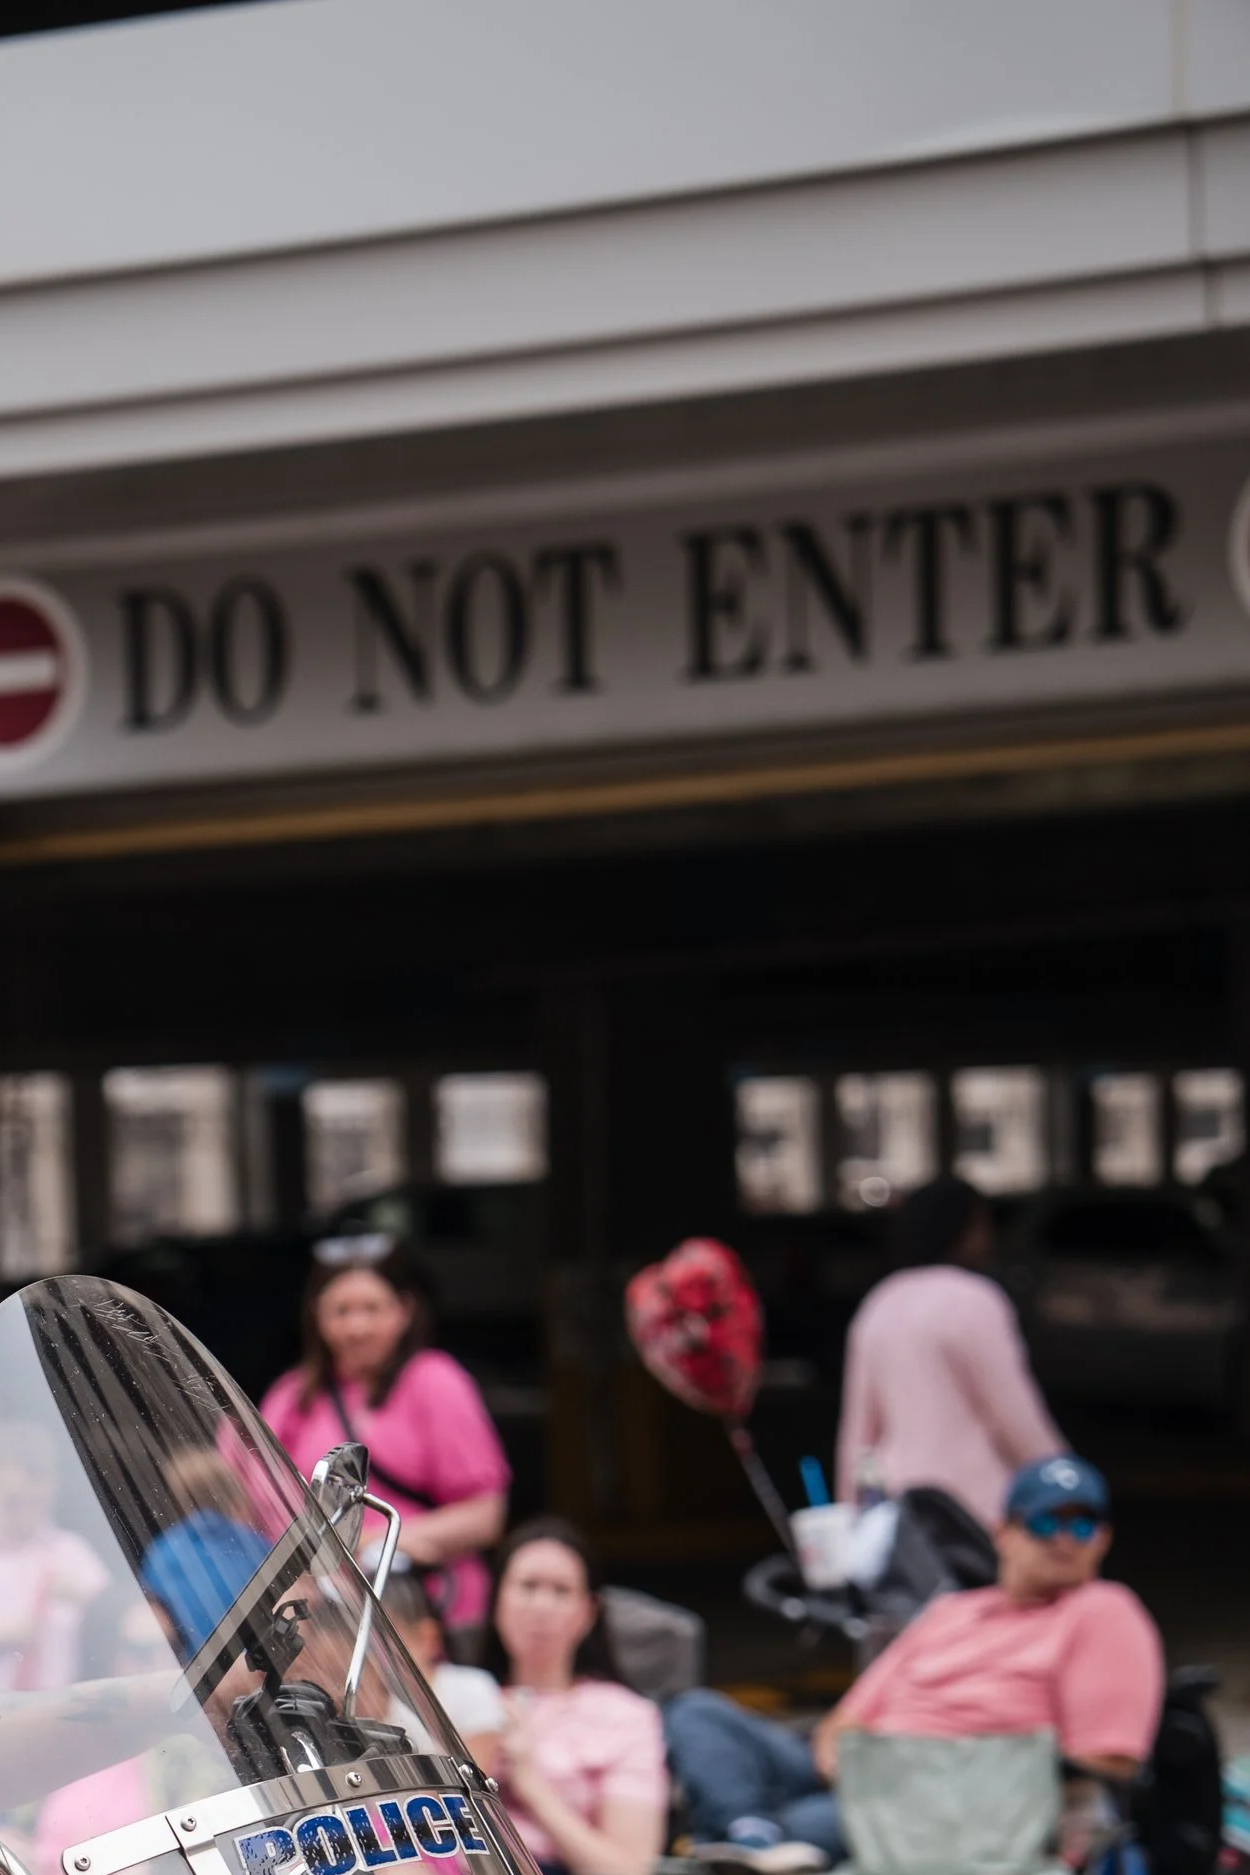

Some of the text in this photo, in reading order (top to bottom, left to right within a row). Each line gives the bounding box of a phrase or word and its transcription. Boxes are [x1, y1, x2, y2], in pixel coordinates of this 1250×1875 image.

[116, 480, 1192, 736] DO NOT ENTER
